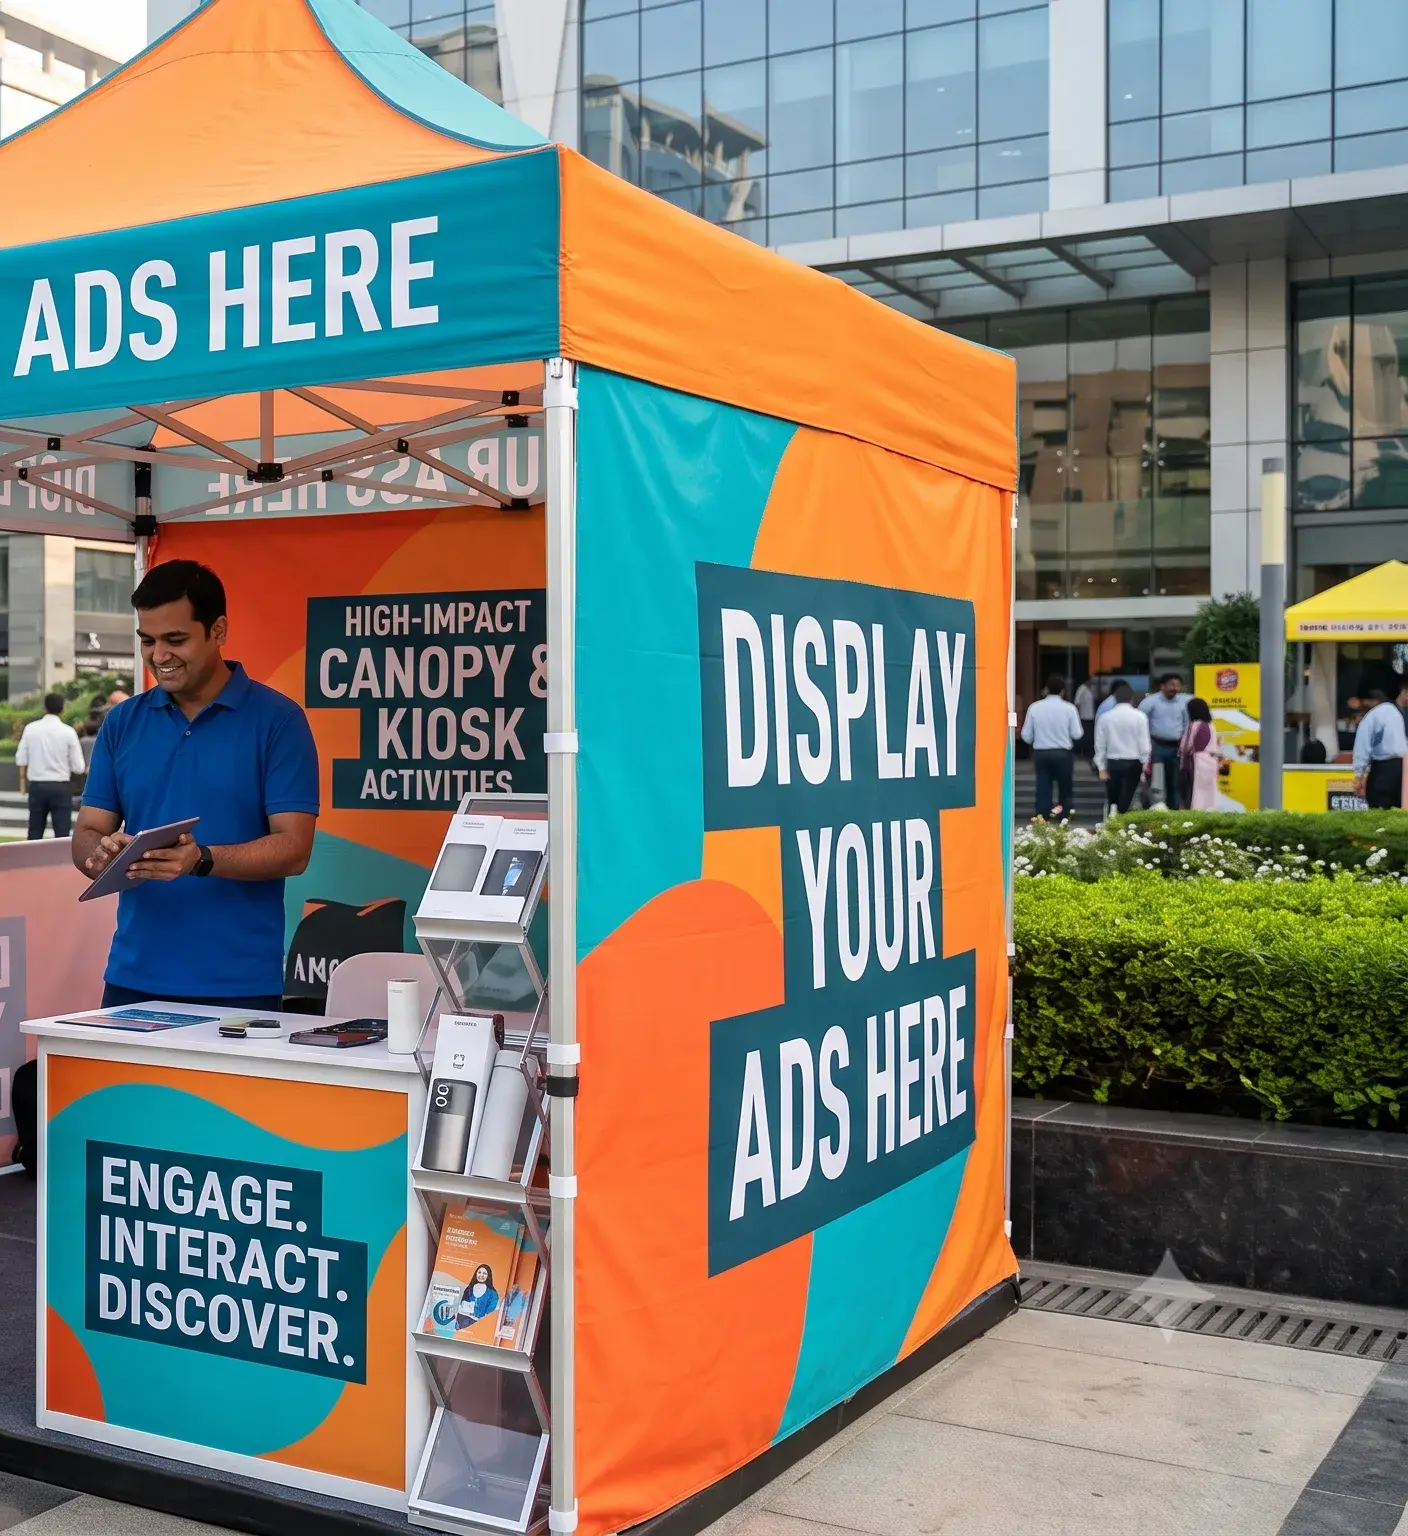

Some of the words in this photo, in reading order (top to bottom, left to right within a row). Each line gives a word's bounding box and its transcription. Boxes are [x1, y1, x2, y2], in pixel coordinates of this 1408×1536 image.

[13, 259, 178, 377] ADS
[209, 215, 440, 352] HERE
[345, 599, 532, 637] HIGH-IMPACT
[319, 644, 516, 699] CANOPY
[528, 643, 548, 699] &
[720, 607, 966, 788] DISPLAY
[378, 706, 526, 761] KIOSK
[359, 768, 513, 801] ACTIVITIES
[795, 818, 936, 990] YOUR
[729, 1025, 851, 1222] ADS
[866, 984, 967, 1163] HERE
[102, 1156, 308, 1233] ENGAGE.
[100, 1214, 348, 1302] INTERACT.
[99, 1273, 355, 1367] DISCOVER.
